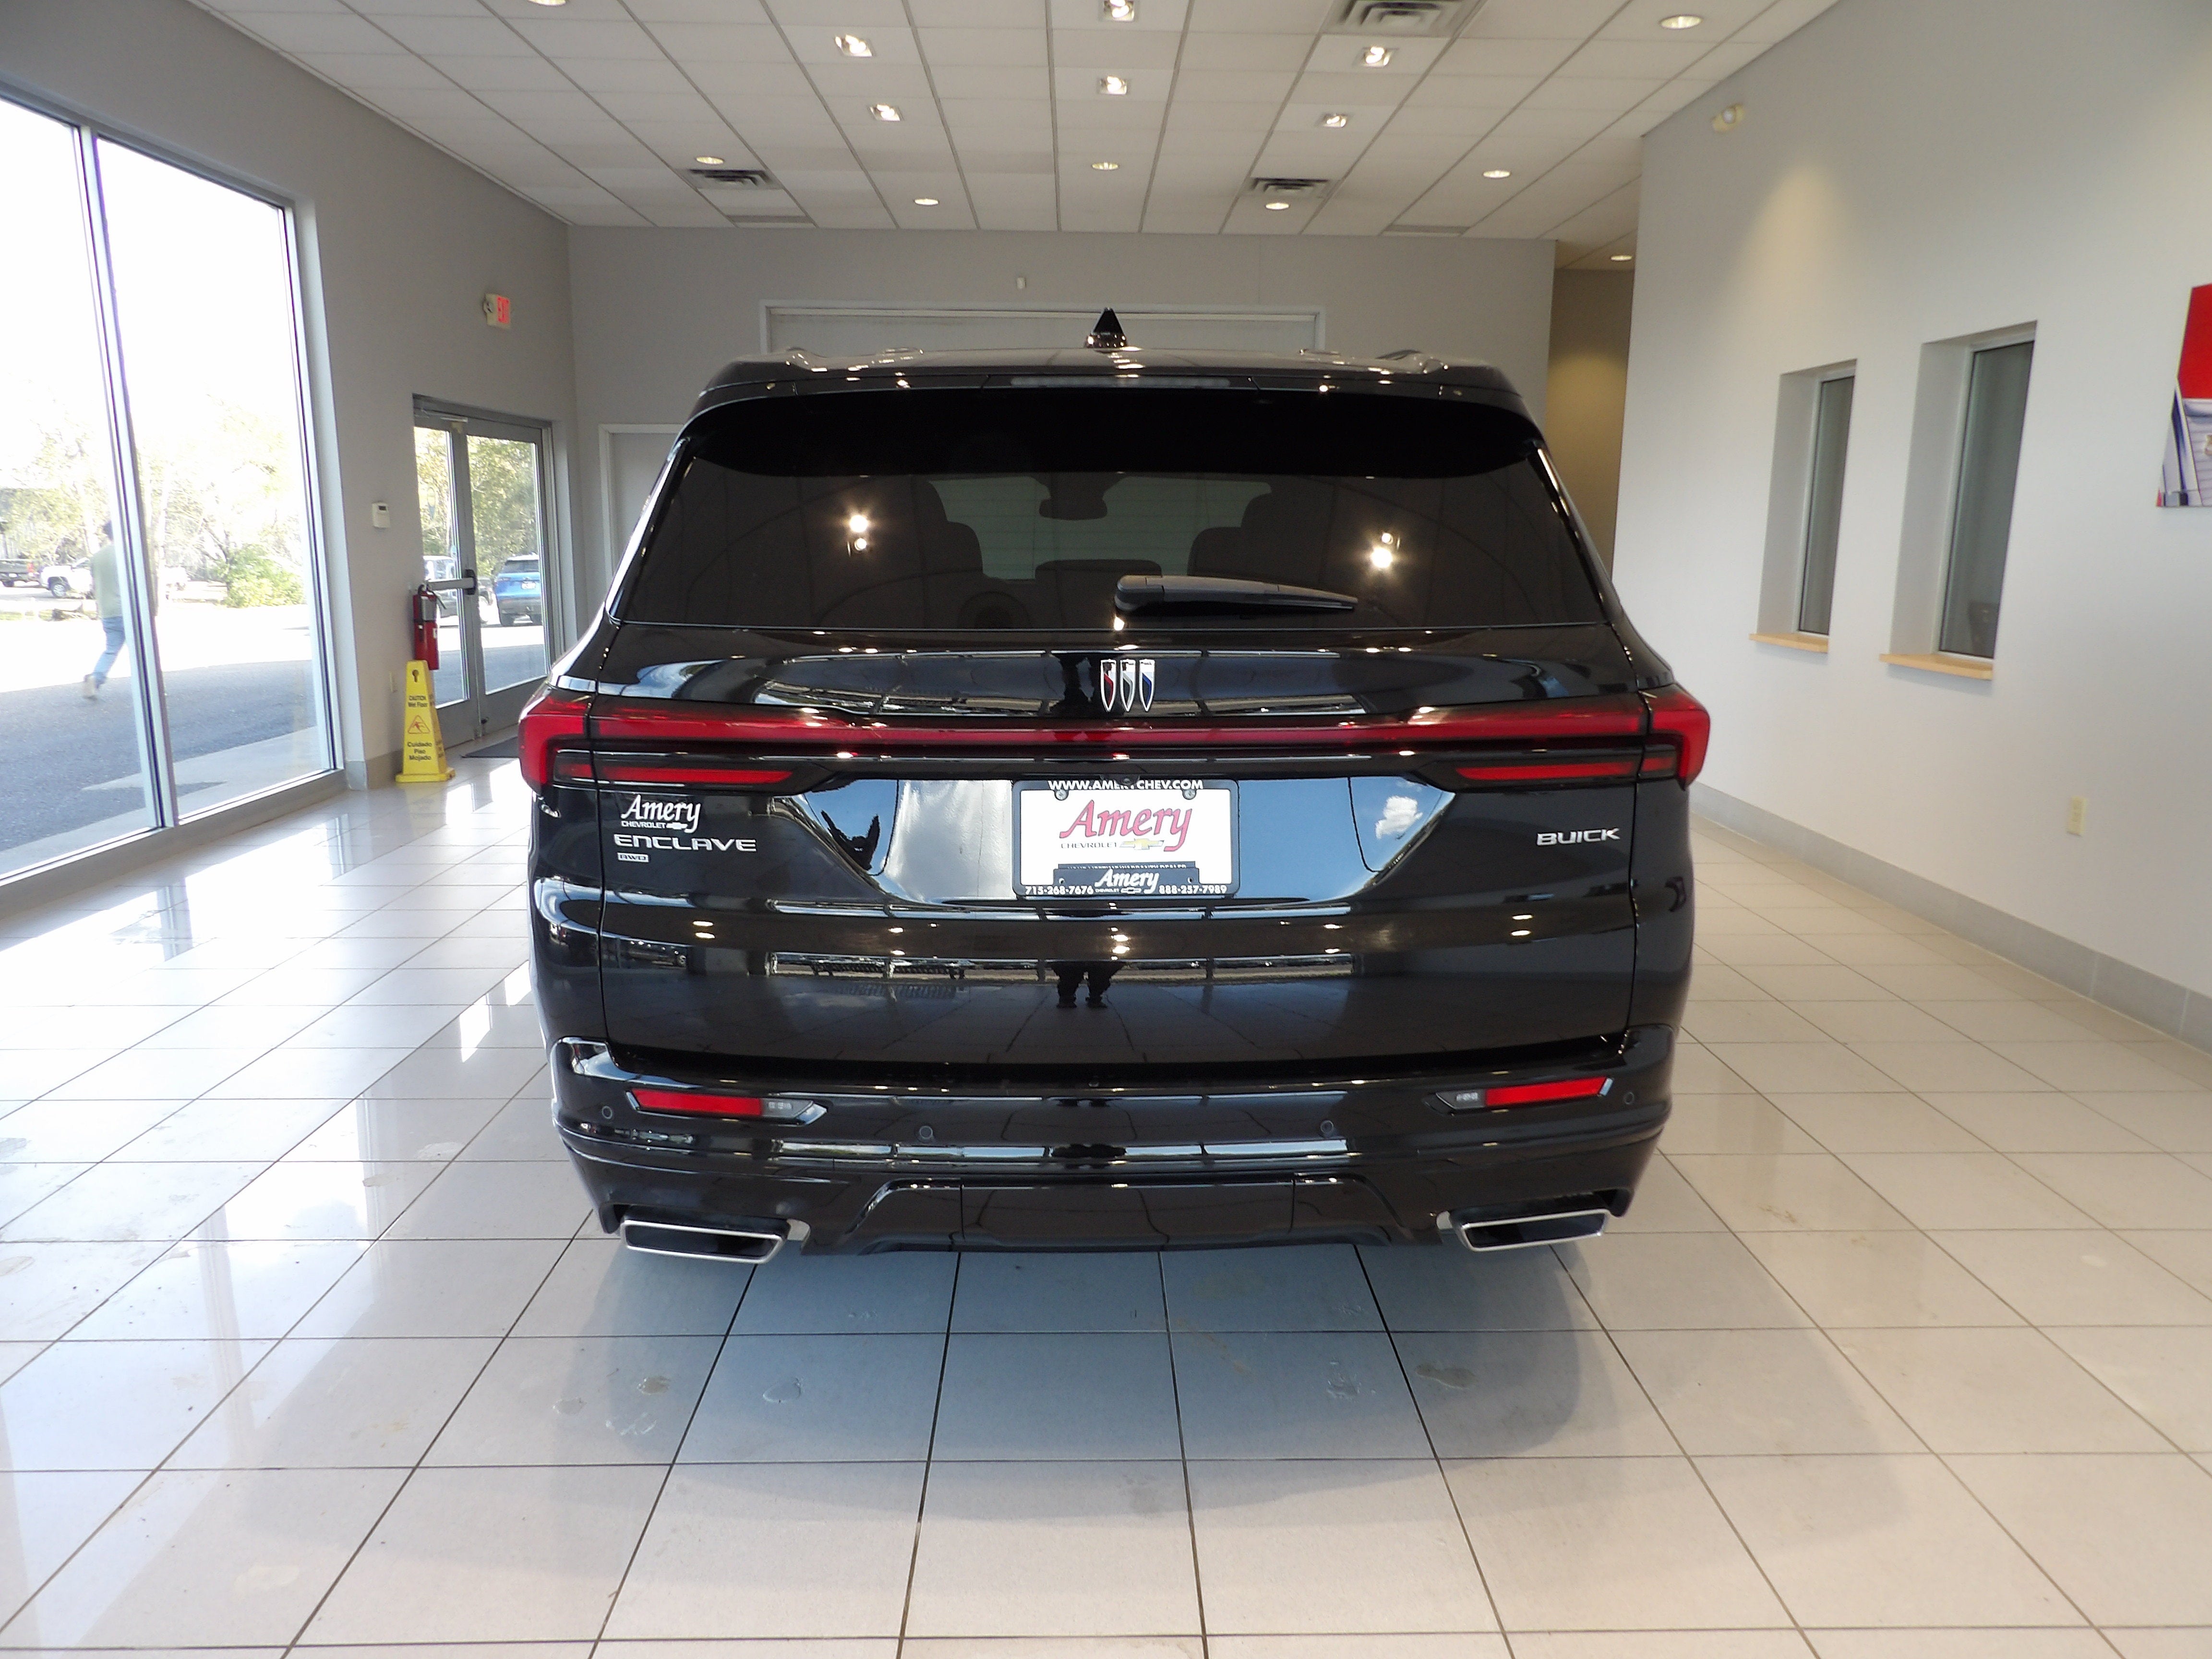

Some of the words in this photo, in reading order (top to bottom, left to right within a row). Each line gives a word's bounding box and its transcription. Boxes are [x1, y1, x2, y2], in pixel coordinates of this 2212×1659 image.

[621, 794, 701, 833] Amery
[621, 820, 666, 829] CHEVROLET
[1059, 799, 1193, 852] Amery
[613, 834, 757, 852] ENCLAVE
[1537, 828, 1621, 846] BUICK
[1094, 868, 1159, 894] Amery
[1159, 885, 1227, 894] 888-257-7989
[1025, 886, 1094, 895] 715-268-7676
